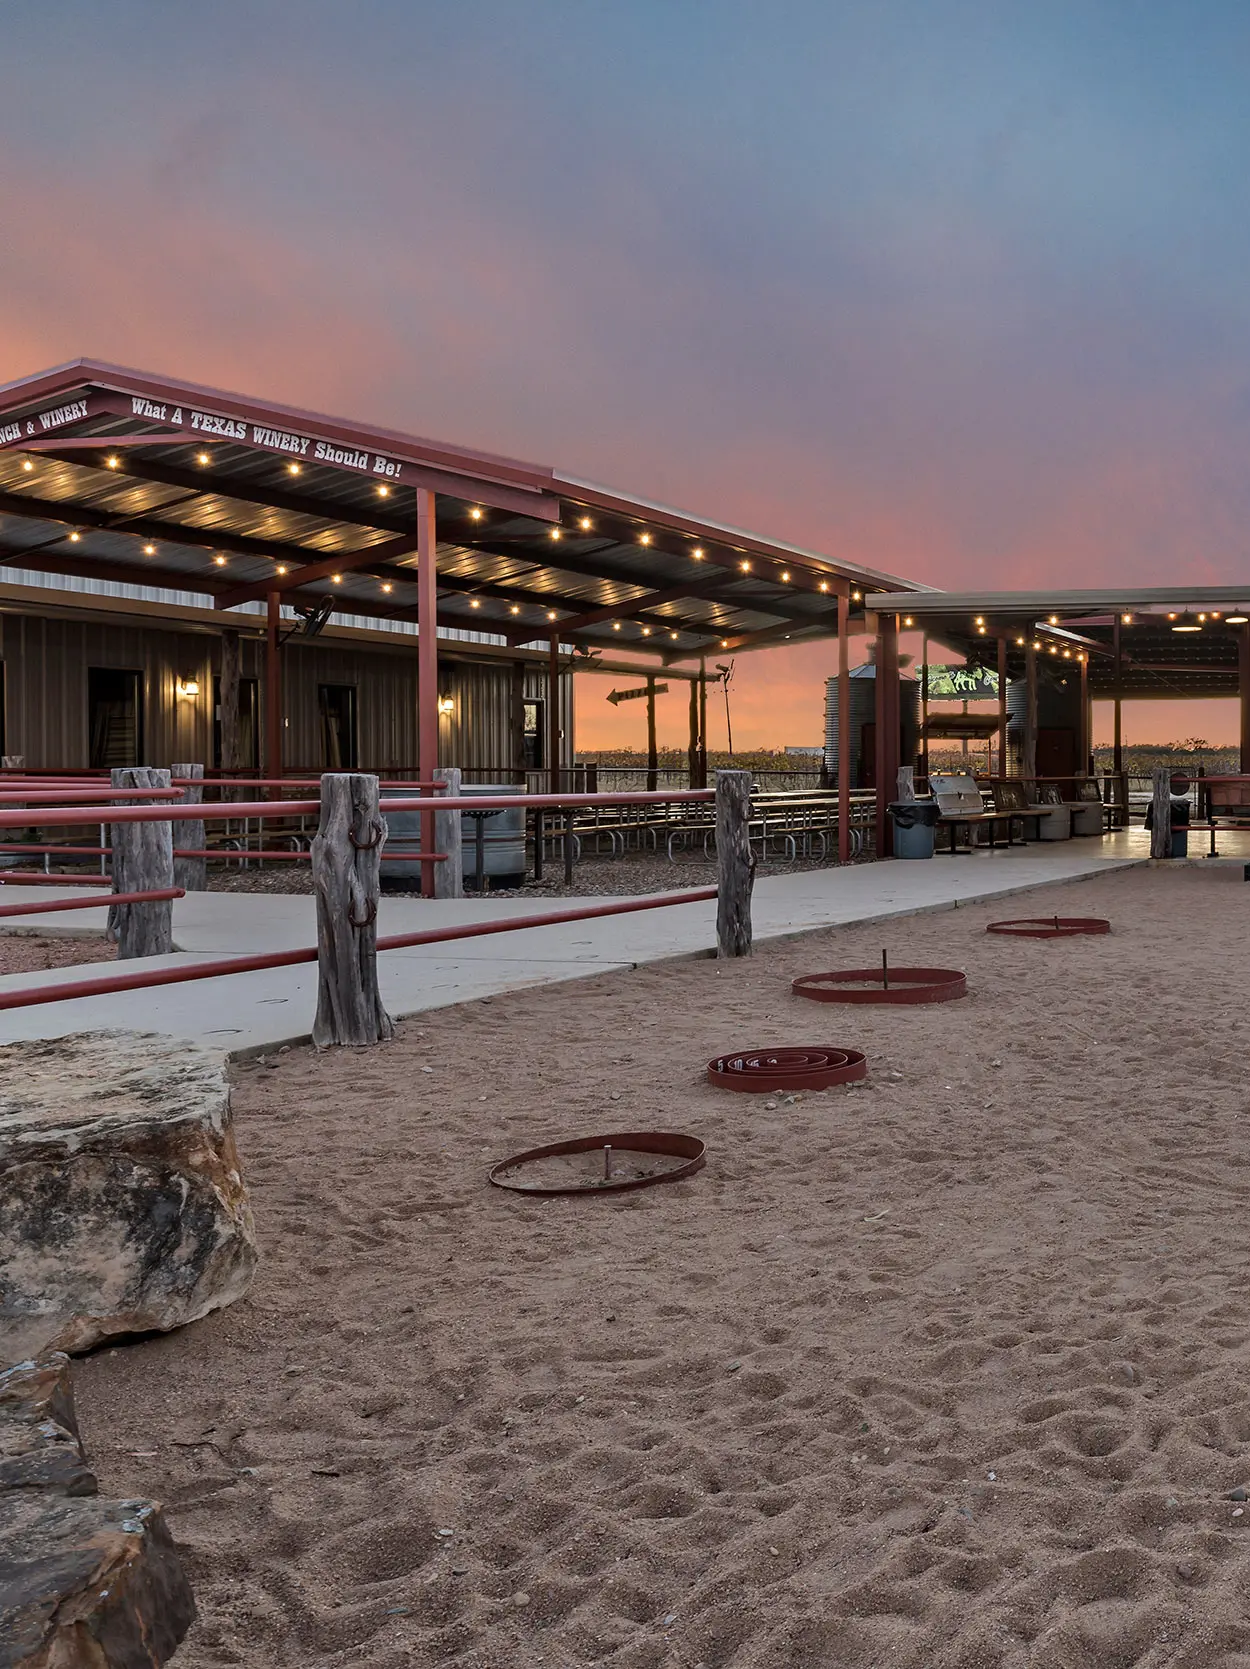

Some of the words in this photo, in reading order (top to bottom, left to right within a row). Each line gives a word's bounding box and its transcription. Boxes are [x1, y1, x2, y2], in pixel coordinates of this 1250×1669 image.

[26, 420, 36, 435] &
[38, 399, 89, 430] WINERY
[131, 397, 167, 421] What
[171, 407, 184, 425] A
[191, 411, 247, 440] TEXAS
[253, 426, 311, 455] WINERY
[314, 441, 369, 470] Should
[372, 456, 403, 478] Be!
